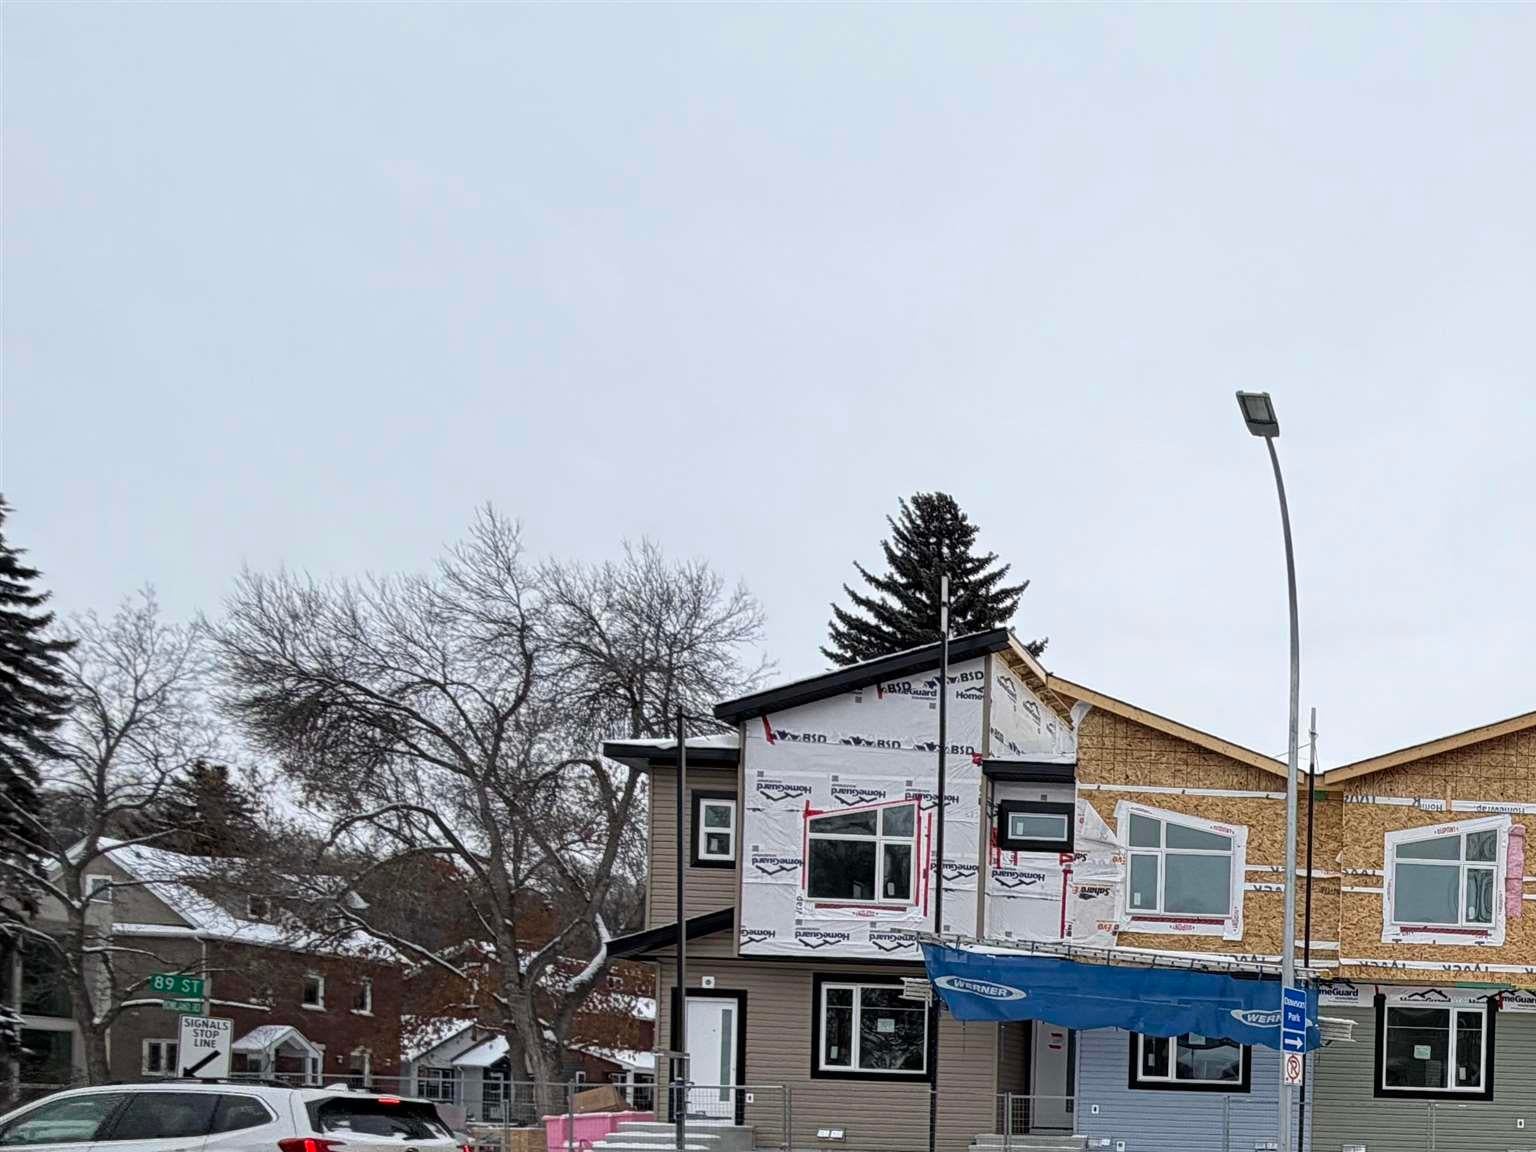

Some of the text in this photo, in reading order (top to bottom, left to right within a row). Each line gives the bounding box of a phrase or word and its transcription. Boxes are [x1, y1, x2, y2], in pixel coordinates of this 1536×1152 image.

[960, 672, 984, 682] BSD
[887, 681, 911, 693] BSD
[956, 691, 984, 700] Home
[802, 733, 827, 743] BSD
[877, 740, 901, 749] BSD
[951, 745, 975, 755] BSD
[756, 783, 812, 794] HomeGuard
[831, 787, 886, 799] HomeGuard
[992, 870, 1046, 882] HomeGuard
[1080, 886, 1111, 896] Sahara
[741, 929, 776, 938] HomeG
[795, 931, 850, 941] HomeGuard
[869, 933, 917, 942] omeGuard
[154, 976, 201, 993] 89 ST
[953, 979, 1008, 997] WERNER
[1288, 1012, 1301, 1022] Park
[184, 1018, 229, 1030] SIGNALS
[193, 1029, 220, 1039] STOP
[194, 1038, 216, 1049] LINE
